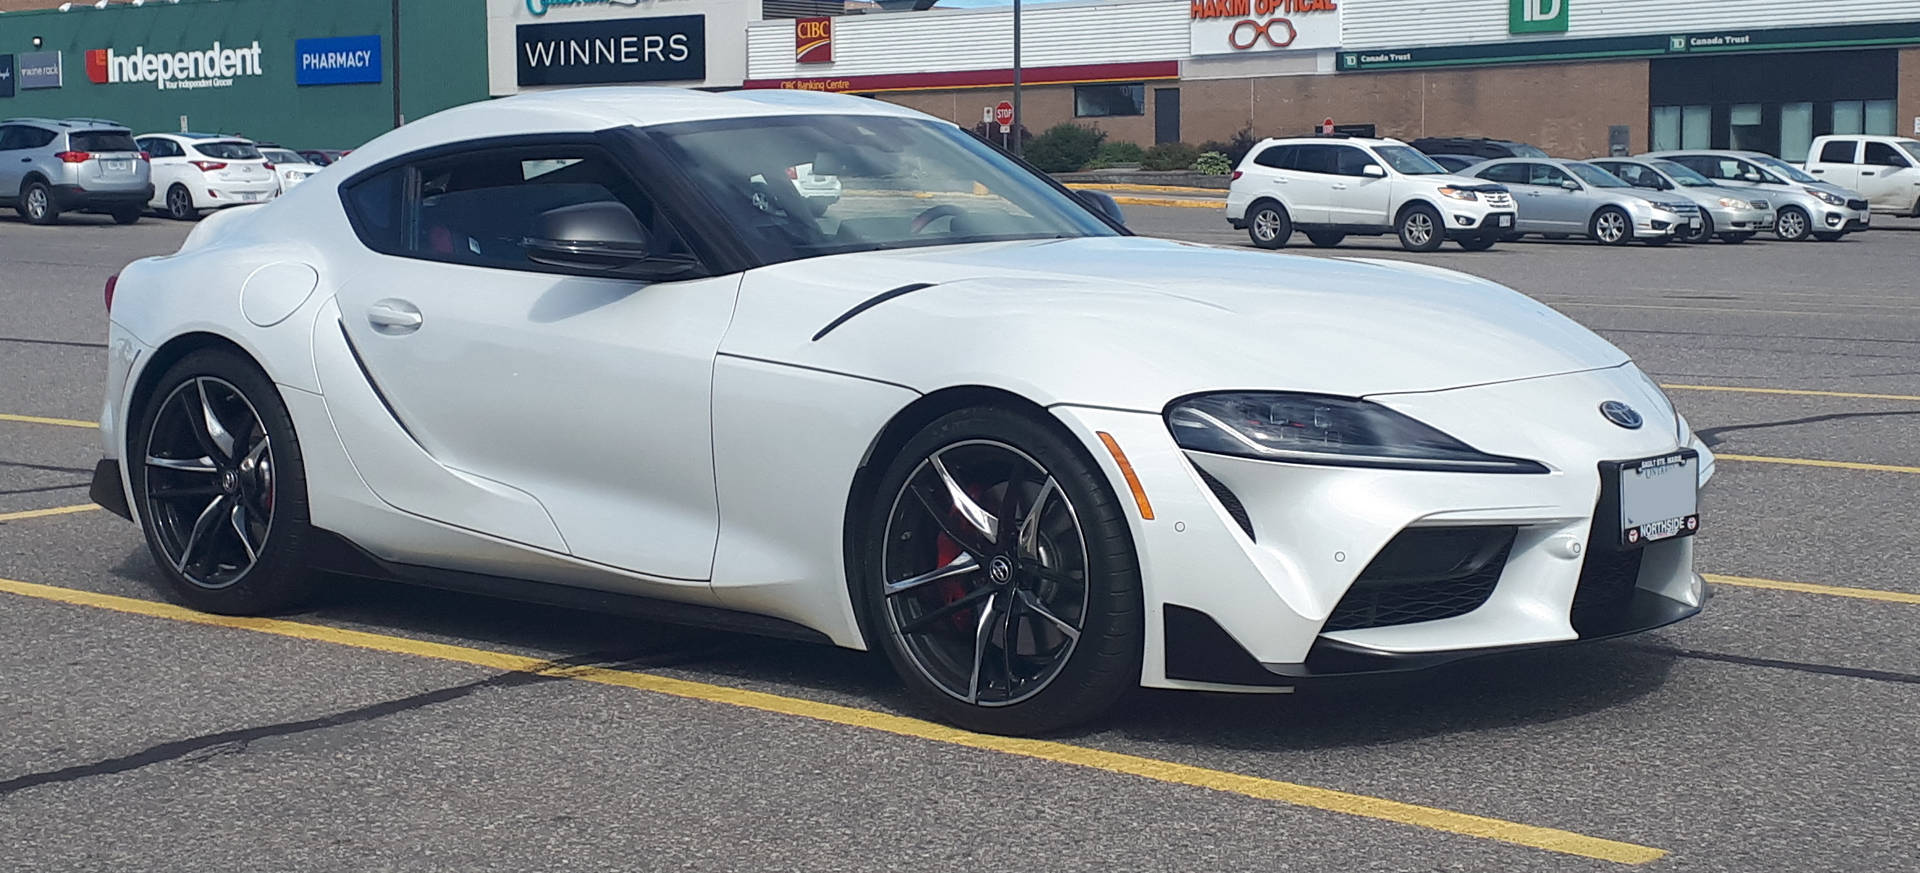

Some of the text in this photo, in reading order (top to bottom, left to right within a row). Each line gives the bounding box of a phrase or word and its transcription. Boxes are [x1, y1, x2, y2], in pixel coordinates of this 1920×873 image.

[1191, 0, 1250, 19] HAKIM
[797, 21, 829, 38] CIBC
[525, 34, 689, 67] WINNERS
[1672, 35, 1750, 49] TD Canada Trust
[107, 41, 262, 89] Independent
[302, 50, 371, 70] PHARMACY
[1345, 53, 1411, 66] TD Canada Trust
[165, 80, 178, 89] Your
[178, 79, 212, 91] Independent
[797, 80, 825, 92] Banking
[826, 80, 850, 89] Centre
[997, 108, 1012, 119] STOP
[1641, 517, 1685, 537] NORTHSIDE
